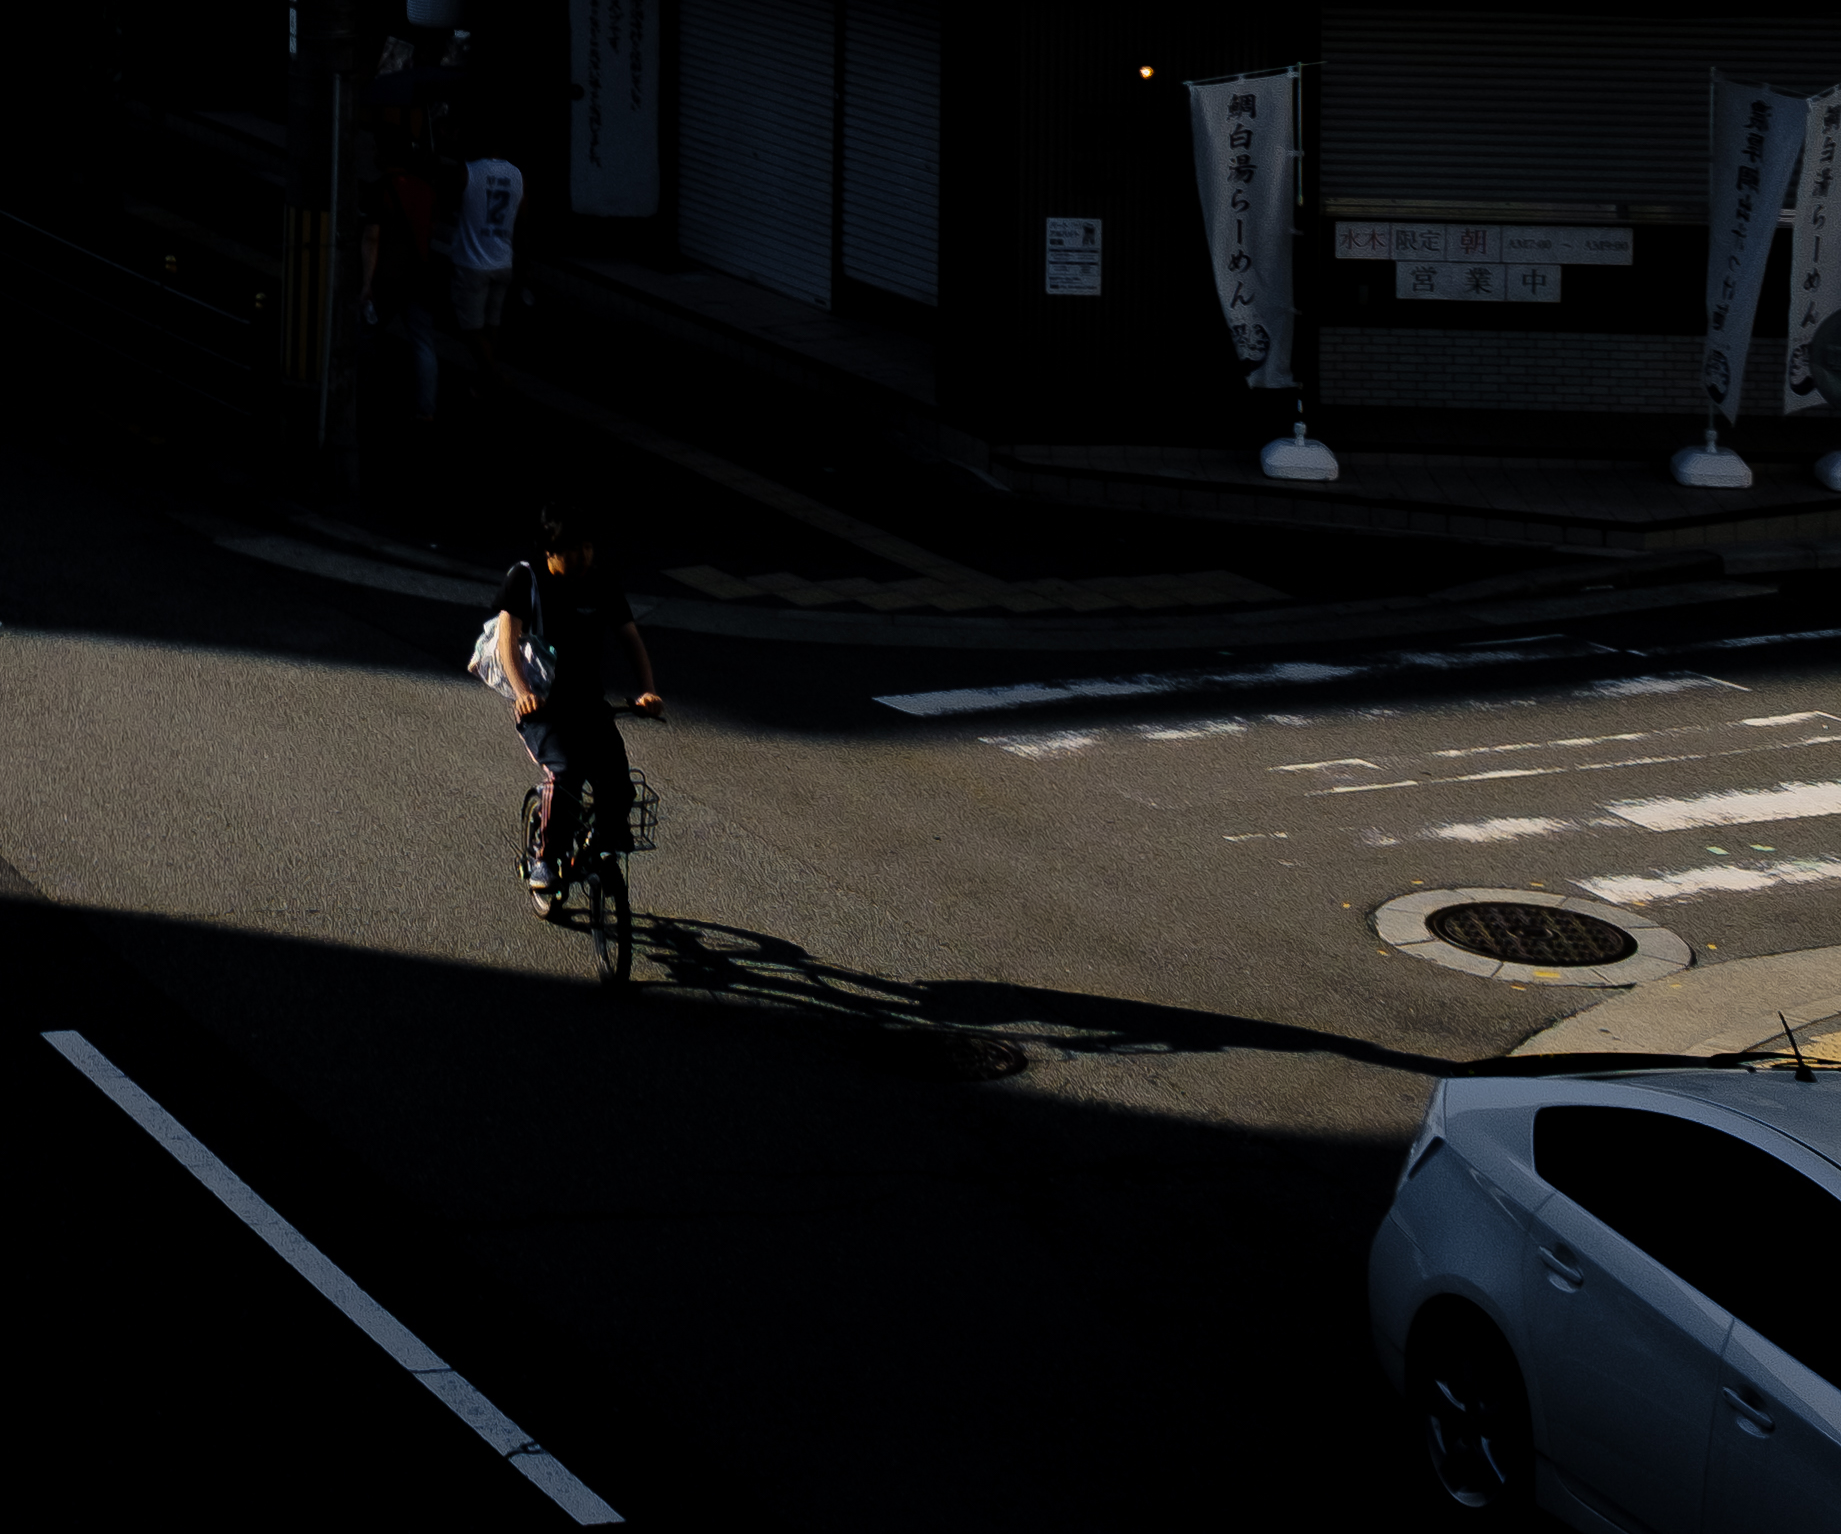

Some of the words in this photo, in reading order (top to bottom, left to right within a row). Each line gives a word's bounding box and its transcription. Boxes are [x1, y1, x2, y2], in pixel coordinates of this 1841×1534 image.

[1227, 93, 1258, 309] 鯛白湯らーめん
[1410, 266, 1548, 296] 営業中
